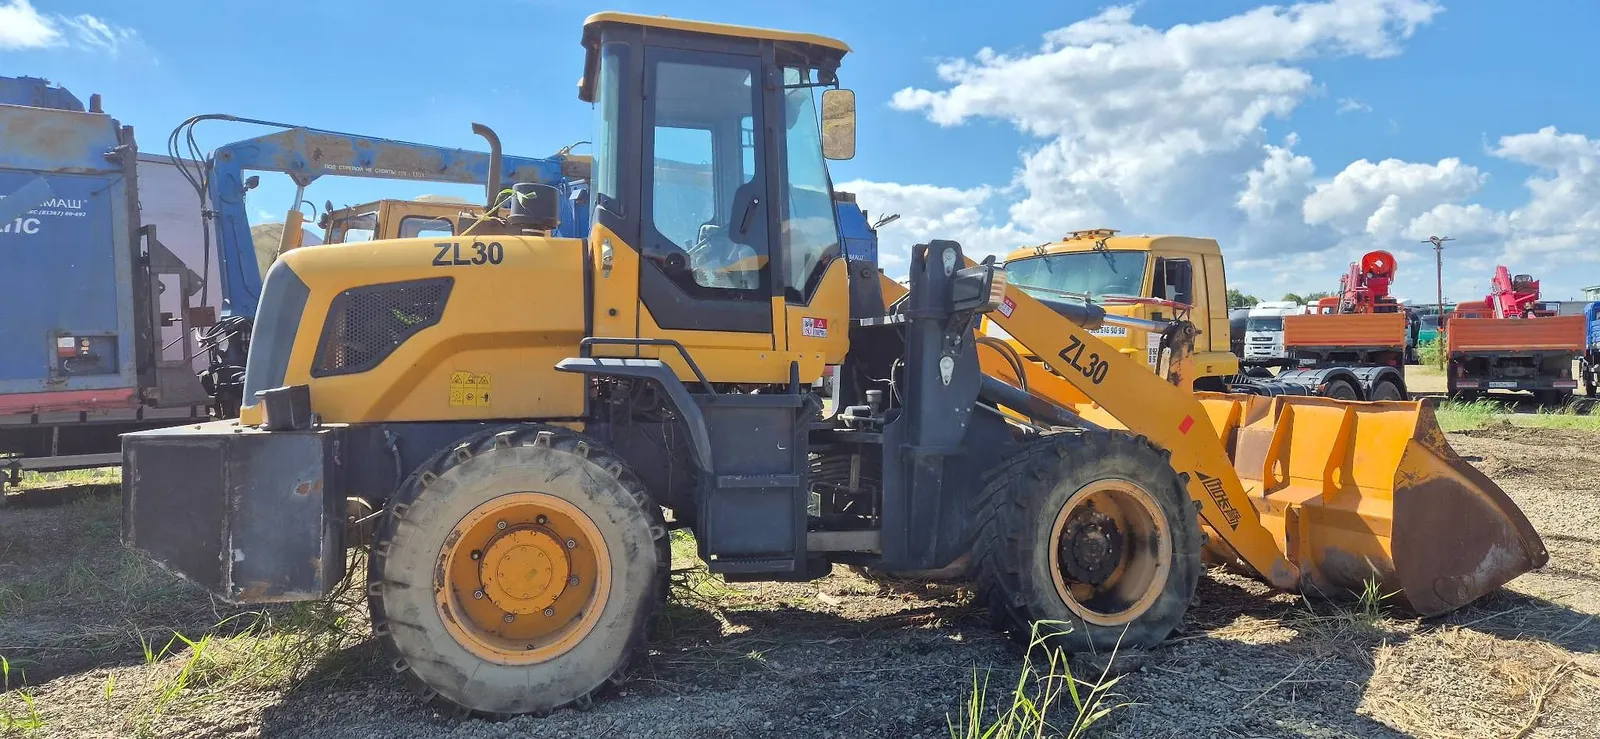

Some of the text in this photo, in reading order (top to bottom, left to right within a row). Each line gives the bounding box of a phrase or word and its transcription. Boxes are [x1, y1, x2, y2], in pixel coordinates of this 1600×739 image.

[40, 198, 81, 209] МАШ
[432, 241, 504, 266] ZL30
[1058, 334, 1109, 385] ZL30
